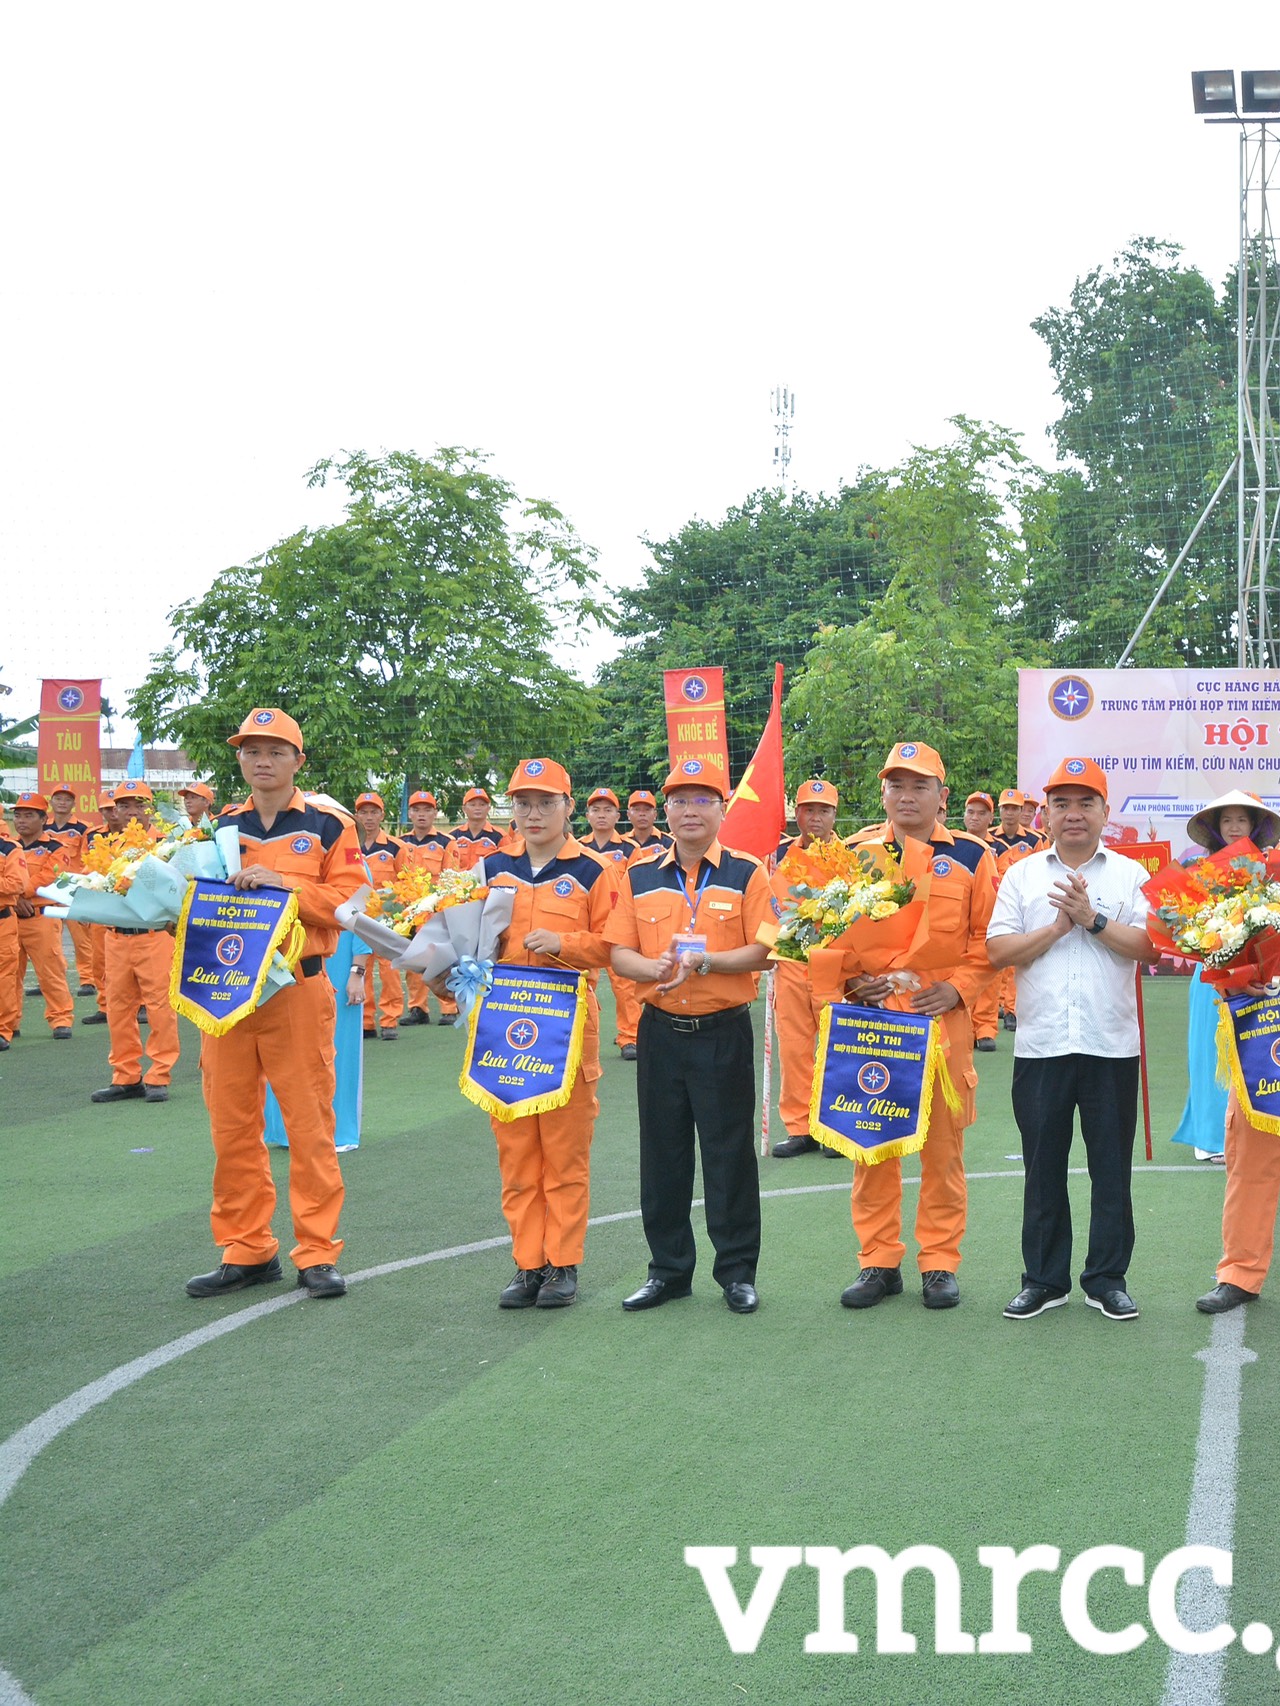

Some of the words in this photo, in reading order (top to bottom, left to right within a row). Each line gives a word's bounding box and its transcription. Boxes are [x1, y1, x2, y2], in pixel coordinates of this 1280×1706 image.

[1197, 682, 1222, 694] CỤC
[1225, 679, 1260, 693] HÀNG
[1101, 700, 1138, 711] TRUNG
[1142, 697, 1166, 711] TÂM
[1169, 696, 1197, 711] PHỐI
[1200, 699, 1224, 714] HỢP
[1227, 697, 1250, 711] TÌM
[1252, 696, 1280, 711] KIẾM
[677, 717, 704, 742] KHỎE
[705, 715, 719, 741] ĐỂ
[1204, 717, 1268, 751] HỘI
[56, 729, 82, 751] TÀU
[43, 760, 60, 782] LÀ
[64, 760, 97, 784] NHÀ,
[1123, 757, 1137, 773] VỤ
[1141, 754, 1162, 771] TÌM
[1165, 753, 1198, 772] KIẾM,
[1202, 753, 1226, 771] CỨU
[1229, 757, 1253, 773] NẠN
[80, 789, 99, 813] CẢ
[1173, 804, 1194, 812] TRUNG
[217, 906, 241, 919] HỘI
[243, 909, 257, 918] THI
[187, 966, 220, 985] Lưu
[211, 991, 232, 1001] 2022
[510, 990, 532, 1003] HỘI
[534, 993, 552, 1004] THI
[1257, 1009, 1280, 1023] HỘI
[857, 1031, 880, 1045] HỘI
[883, 1035, 902, 1046] THI
[478, 1050, 508, 1069] Lưu
[512, 1053, 555, 1077] Niệm
[498, 1074, 525, 1086] 2022
[829, 1094, 863, 1113] Lưu
[867, 1097, 910, 1122] Niệm
[855, 1120, 882, 1131] 2022
